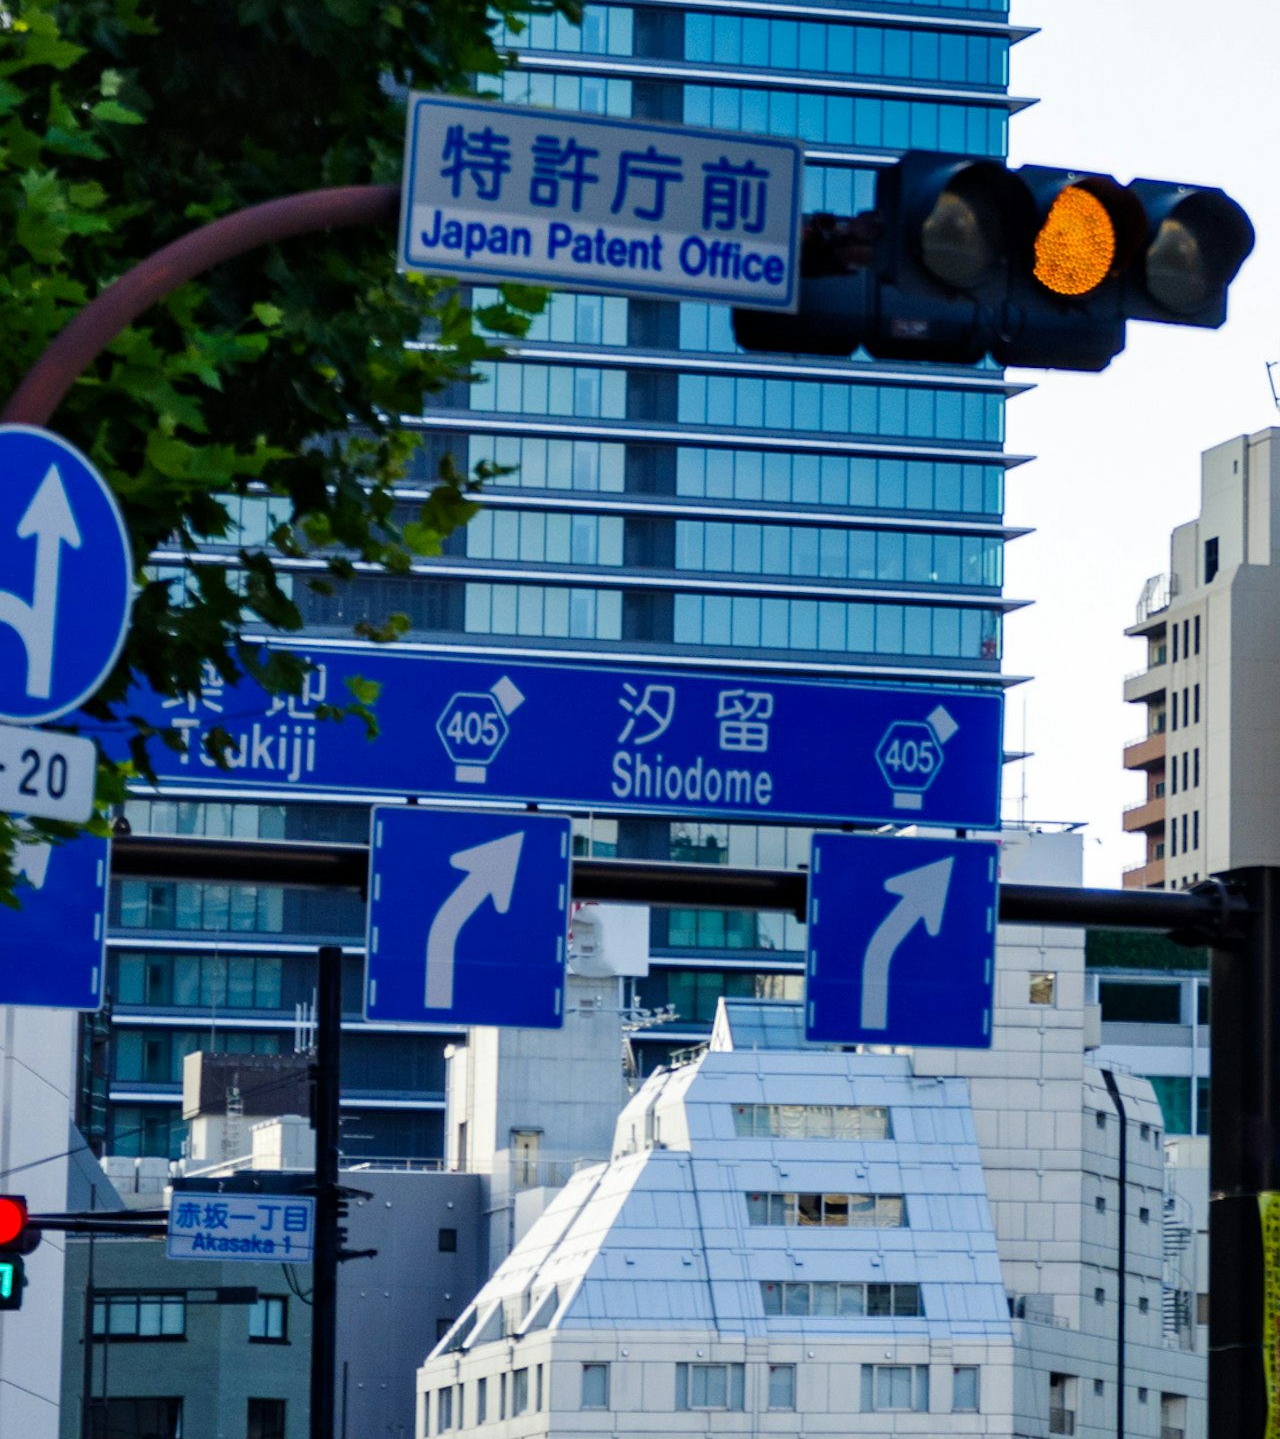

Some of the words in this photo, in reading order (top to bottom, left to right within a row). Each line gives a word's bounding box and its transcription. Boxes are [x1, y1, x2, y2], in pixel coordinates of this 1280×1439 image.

[440, 124, 771, 234] 特許庁前
[421, 209, 531, 259] Japan
[547, 222, 663, 272] Patent
[678, 234, 784, 284] Office
[446, 711, 499, 746] 405
[618, 682, 773, 753] 汐留
[611, 751, 774, 806] Shiodome
[884, 740, 935, 774] 405
[176, 1202, 308, 1232] 赤坂一丁目
[191, 1233, 275, 1254] Akasaka
[282, 1235, 291, 1254] 1
